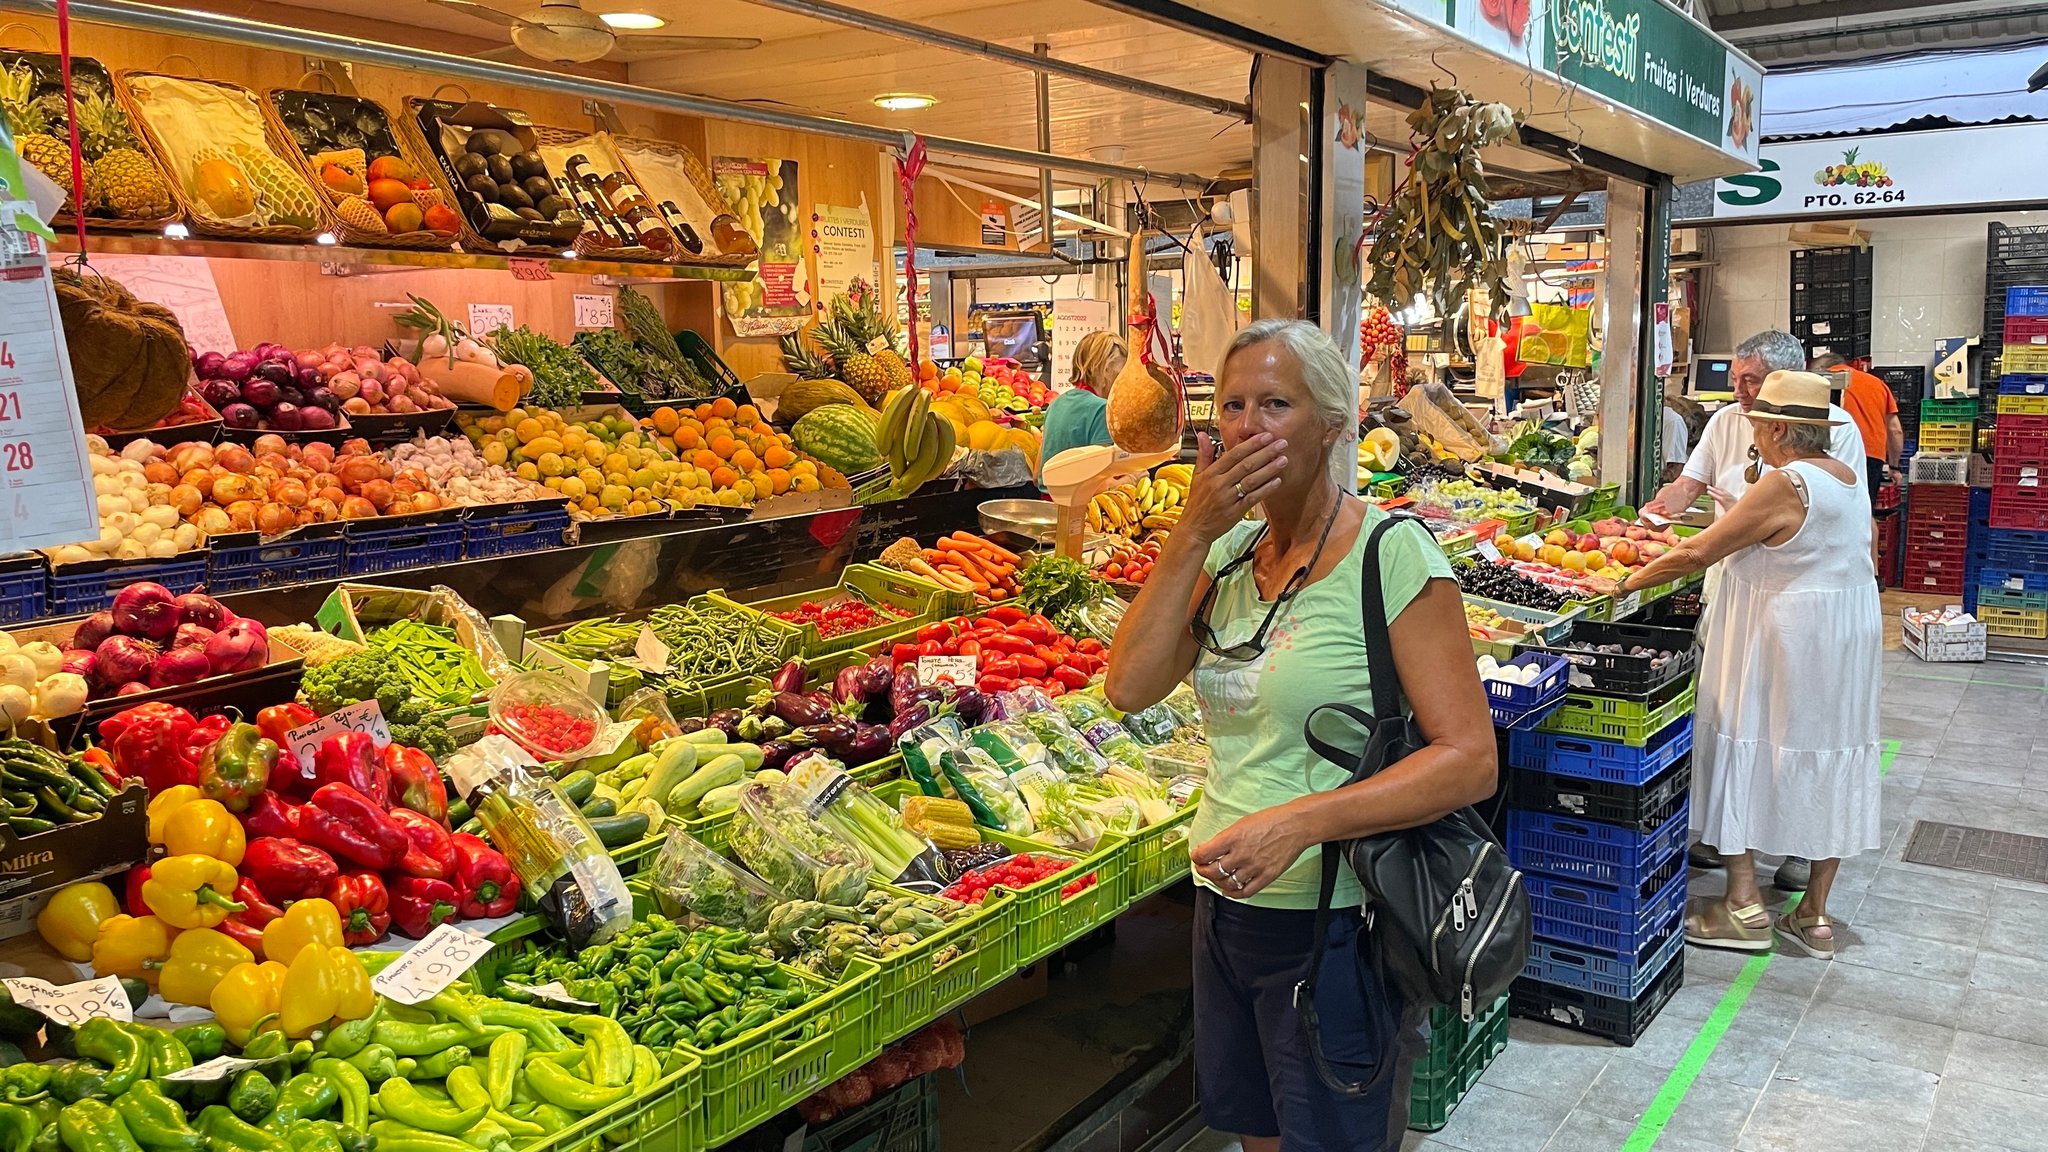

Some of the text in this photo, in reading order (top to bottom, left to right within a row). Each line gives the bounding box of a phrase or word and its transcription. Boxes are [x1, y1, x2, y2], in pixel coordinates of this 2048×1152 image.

[1644, 52, 1720, 118] Fruites i Verdures
[1716, 158, 1782, 206] S
[1804, 189, 1906, 208] PTO. 62-64
[578, 305, 609, 326] 1'85
[0, 391, 22, 421] 21
[3, 441, 34, 472] 28
[1, 850, 54, 873] Mifra
[400, 946, 470, 999] 4'98
